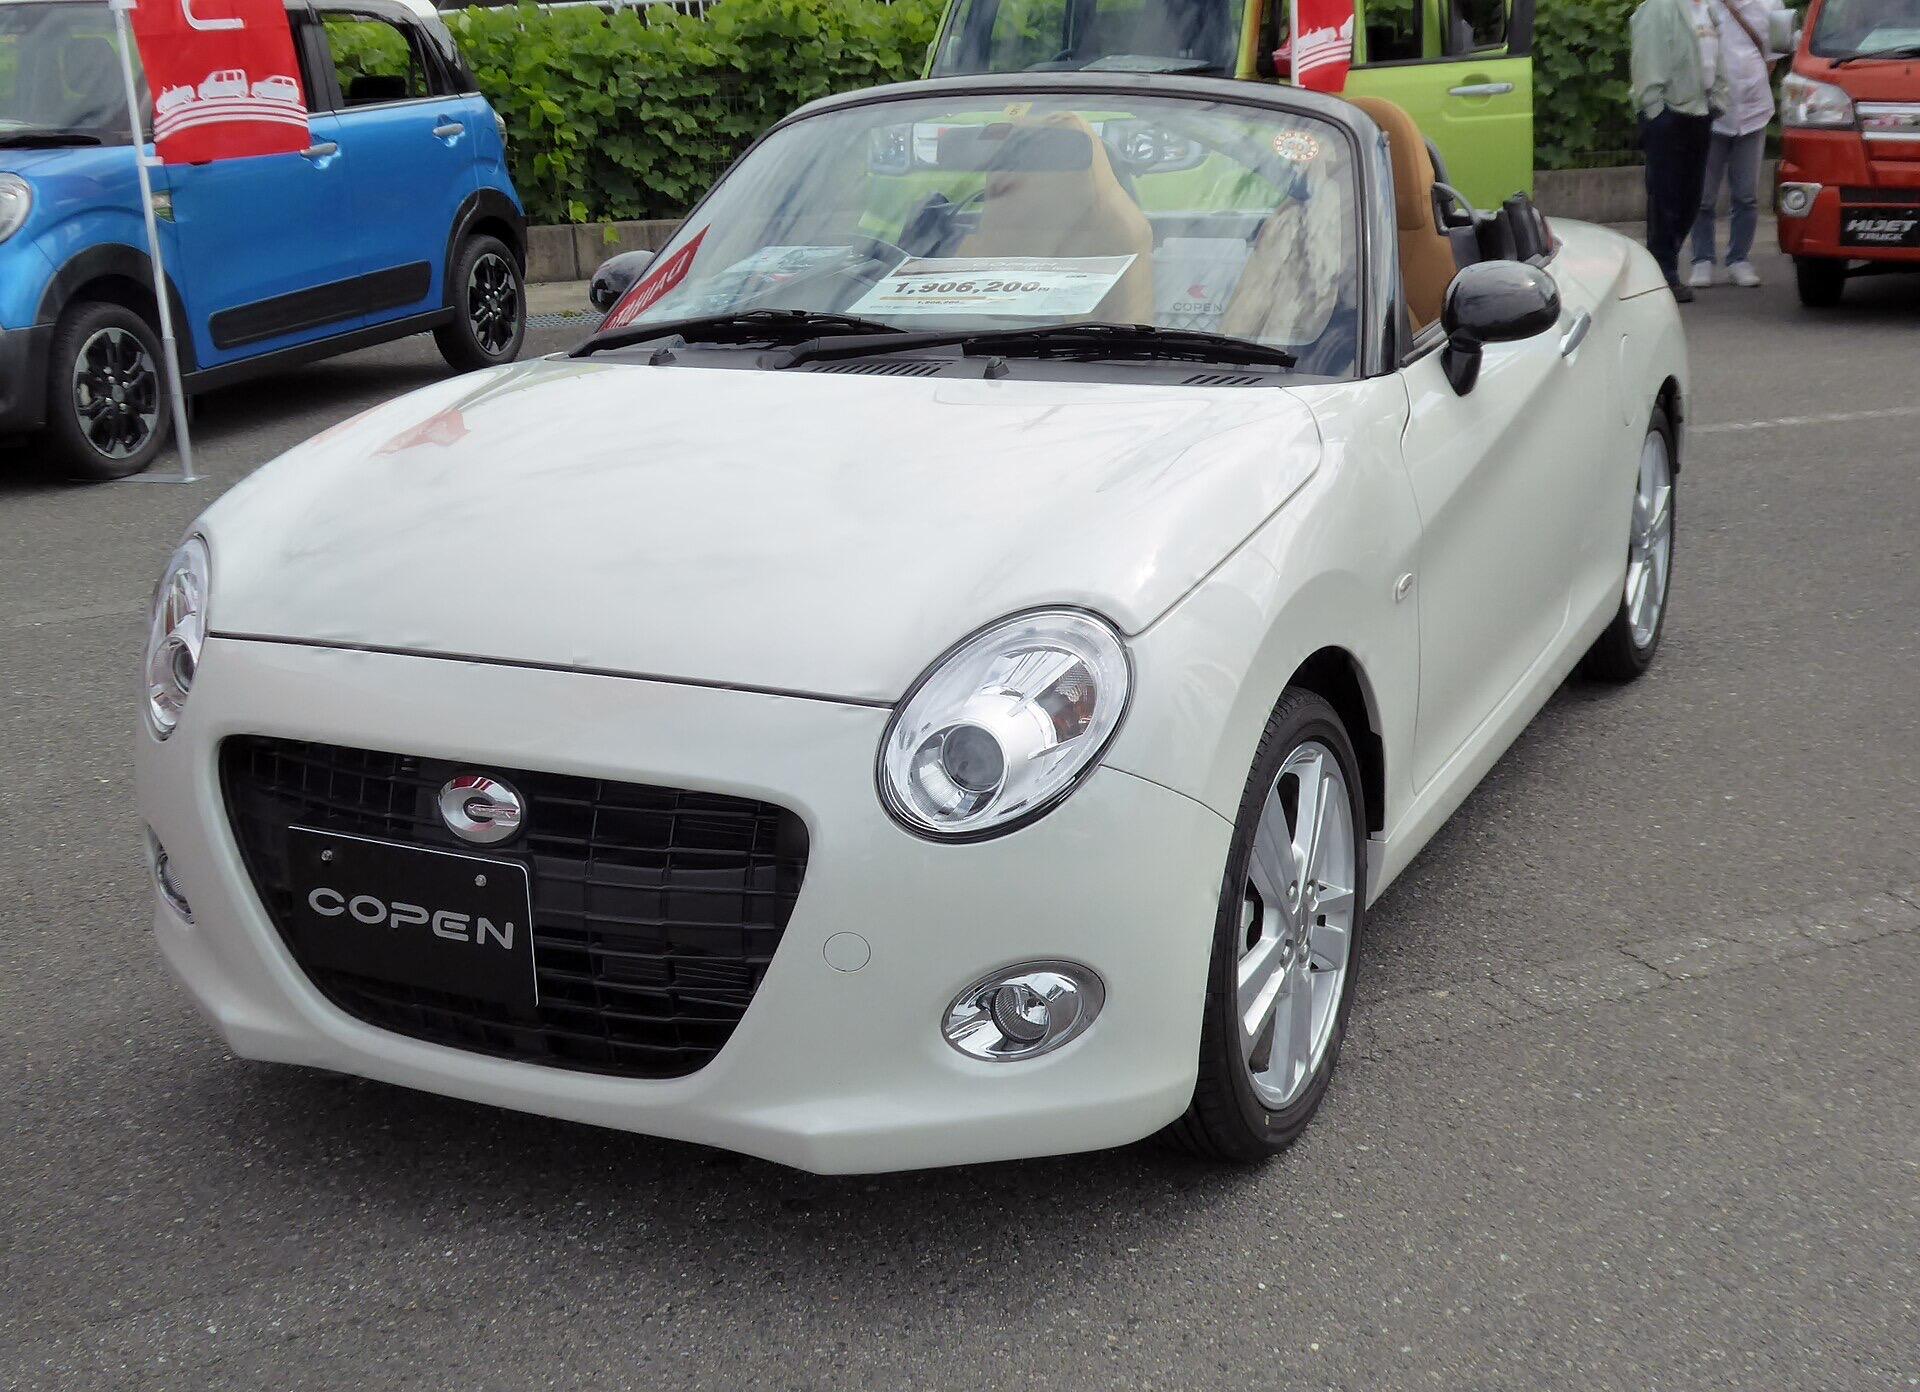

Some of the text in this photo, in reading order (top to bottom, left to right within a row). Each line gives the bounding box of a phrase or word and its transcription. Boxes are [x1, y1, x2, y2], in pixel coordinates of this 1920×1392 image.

[1846, 219, 1918, 232] HIJET
[1856, 232, 1904, 240] TRUCK
[895, 281, 1041, 295] 1,906,200
[1172, 302, 1223, 312] COPEN
[308, 887, 514, 950] COPEN
